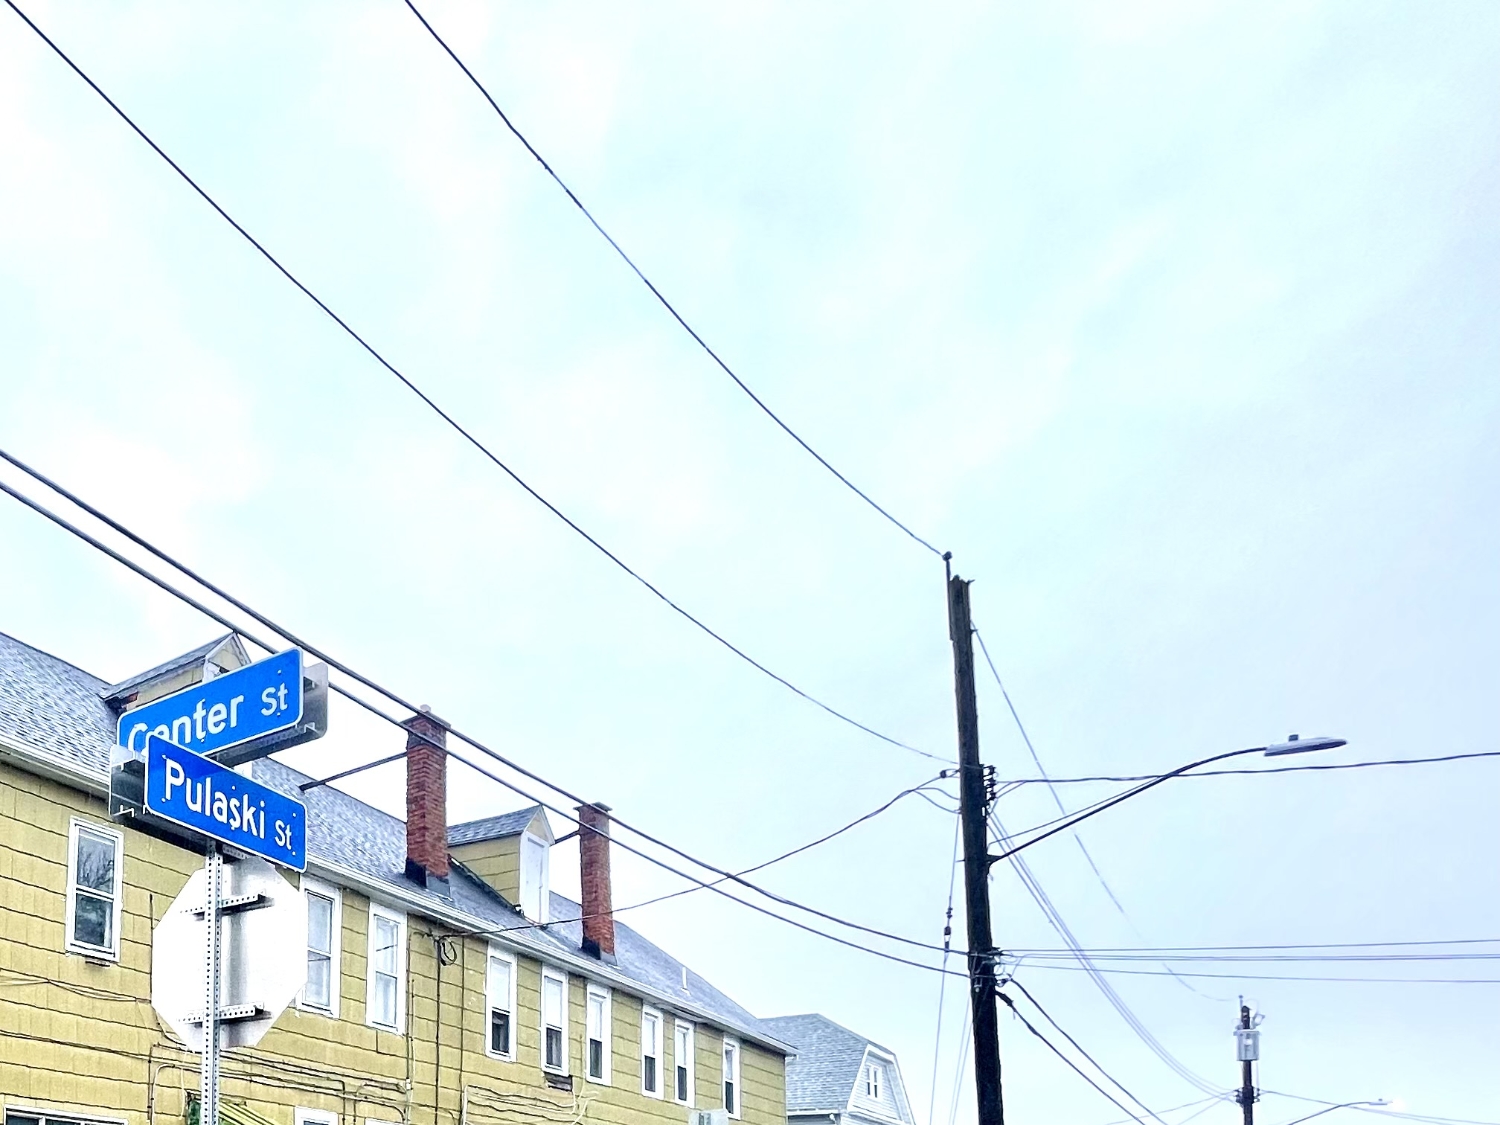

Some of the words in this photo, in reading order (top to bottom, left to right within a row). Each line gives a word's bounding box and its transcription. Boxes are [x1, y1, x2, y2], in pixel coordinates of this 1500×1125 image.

[261, 683, 288, 716] St
[165, 759, 265, 839] Pulaski
[274, 820, 292, 850] St
